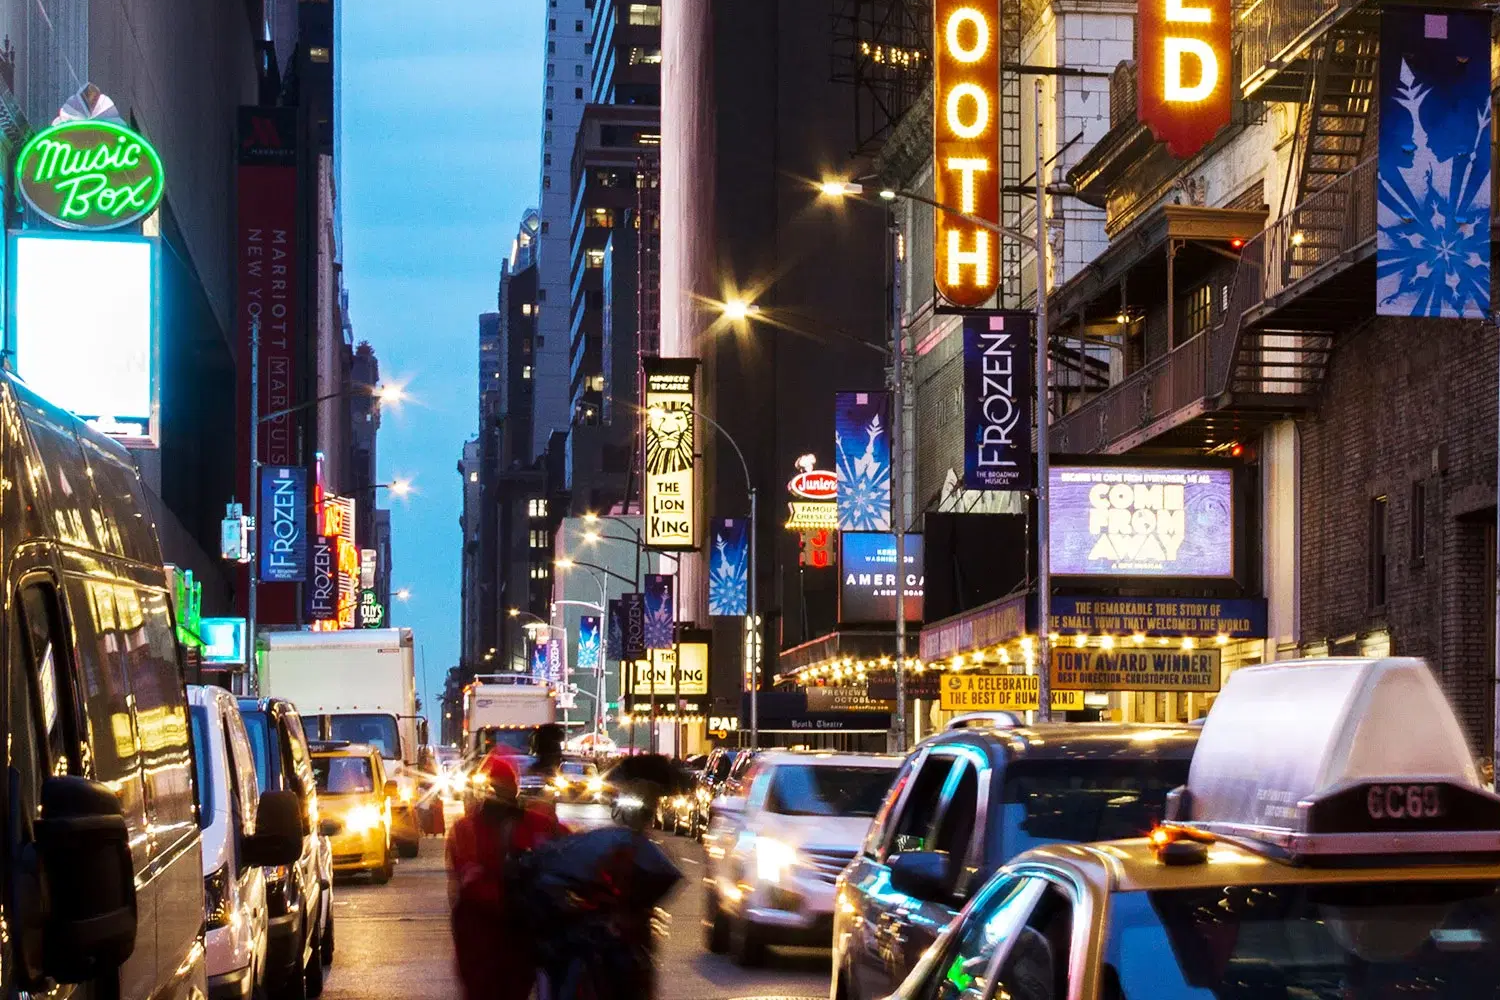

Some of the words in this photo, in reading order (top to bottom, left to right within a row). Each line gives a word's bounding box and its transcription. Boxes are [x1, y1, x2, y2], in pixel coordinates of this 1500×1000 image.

[35, 134, 142, 183] Music
[54, 172, 153, 220] Box
[247, 228, 263, 277] NEW
[271, 229, 287, 349] MARRIOTT
[977, 333, 1021, 467] FROZEN
[657, 482, 680, 493] THE
[797, 474, 838, 491] Junior
[653, 495, 685, 515] LION
[1089, 483, 1184, 510] COME
[270, 479, 299, 567] FROZEN
[651, 516, 690, 539] KING
[1089, 508, 1185, 535] FROM
[1087, 534, 1184, 561] AWAY
[311, 544, 334, 611] FROZEN
[846, 573, 925, 586] AMERC
[1076, 602, 1092, 614] THE
[1094, 602, 1153, 615] REMARKABLE
[1156, 603, 1177, 616] TRUE
[1179, 603, 1208, 616] STORY
[1210, 604, 1222, 616] OF
[1062, 616, 1092, 629] SMALL
[1094, 616, 1121, 630] TOWN
[1122, 617, 1146, 630] THAT
[1147, 617, 1198, 631] WELCOMED
[1199, 618, 1217, 631] THE
[661, 652, 675, 660] THE
[1056, 652, 1092, 672] TONY
[1095, 653, 1148, 673] AWARD
[1152, 654, 1213, 674] WINNER!
[968, 677, 975, 691] A
[977, 677, 1038, 691] CELEBRATIO
[1181, 673, 1212, 686] ASHLEY
[950, 691, 968, 705] THE
[971, 691, 996, 705] BEST
[999, 691, 1013, 705] OF
[1015, 691, 1075, 705] HUMKIND
[791, 719, 813, 729] Booth
[816, 719, 844, 729] Theatre
